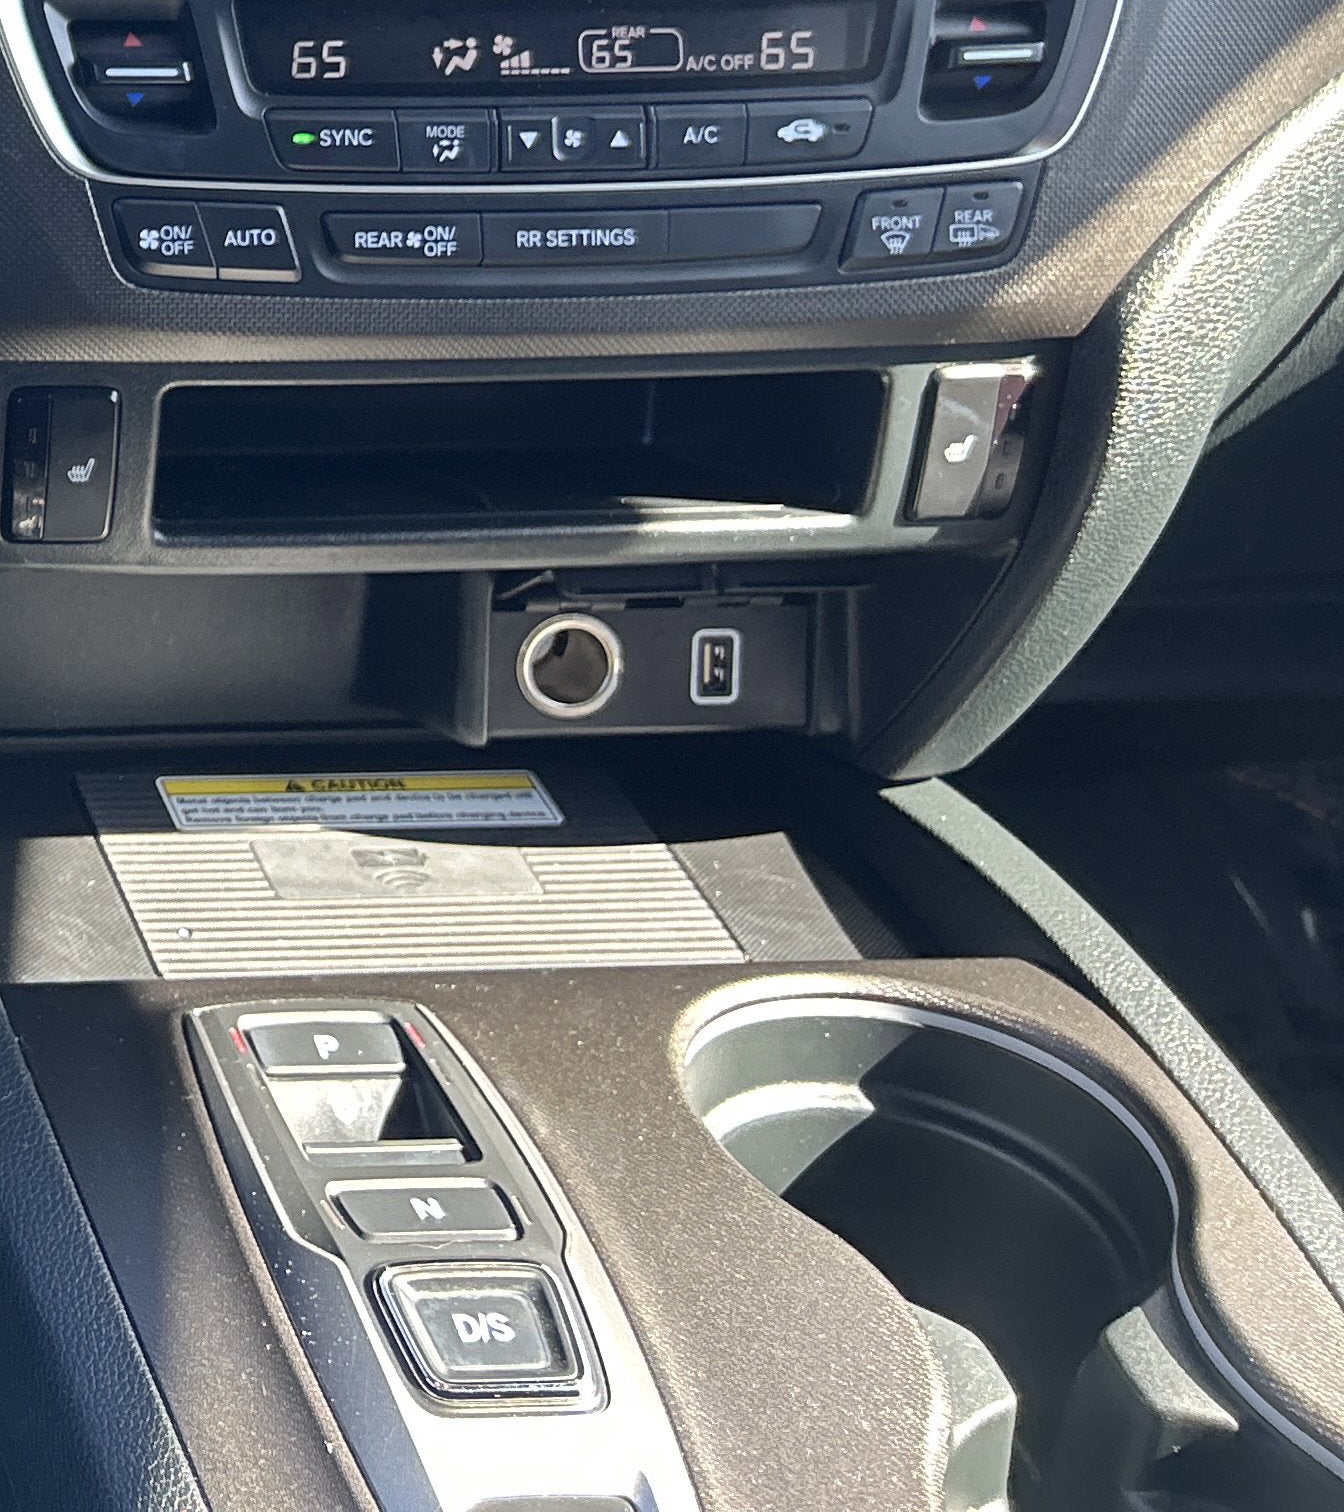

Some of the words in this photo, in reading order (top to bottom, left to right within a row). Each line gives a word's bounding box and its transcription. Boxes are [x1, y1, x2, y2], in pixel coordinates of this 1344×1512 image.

[611, 26, 646, 39] REAR
[291, 39, 348, 79] 65
[591, 39, 633, 69] 65
[686, 54, 717, 73] A/C
[720, 53, 754, 72] OFF
[759, 31, 815, 70] 65
[318, 129, 374, 147] SYNC
[425, 125, 466, 139] MODE
[683, 126, 719, 145] A/C
[871, 215, 922, 232] FRONT
[954, 209, 994, 224] REAR
[224, 229, 276, 247] AUTO
[354, 231, 402, 249] REAR
[515, 230, 545, 248] RR
[547, 229, 636, 248] SETTINGS
[160, 240, 194, 256] OFF
[423, 240, 457, 257] OFF
[313, 1033, 339, 1060] P
[410, 1197, 446, 1221] N
[452, 1312, 515, 1344] D/S
